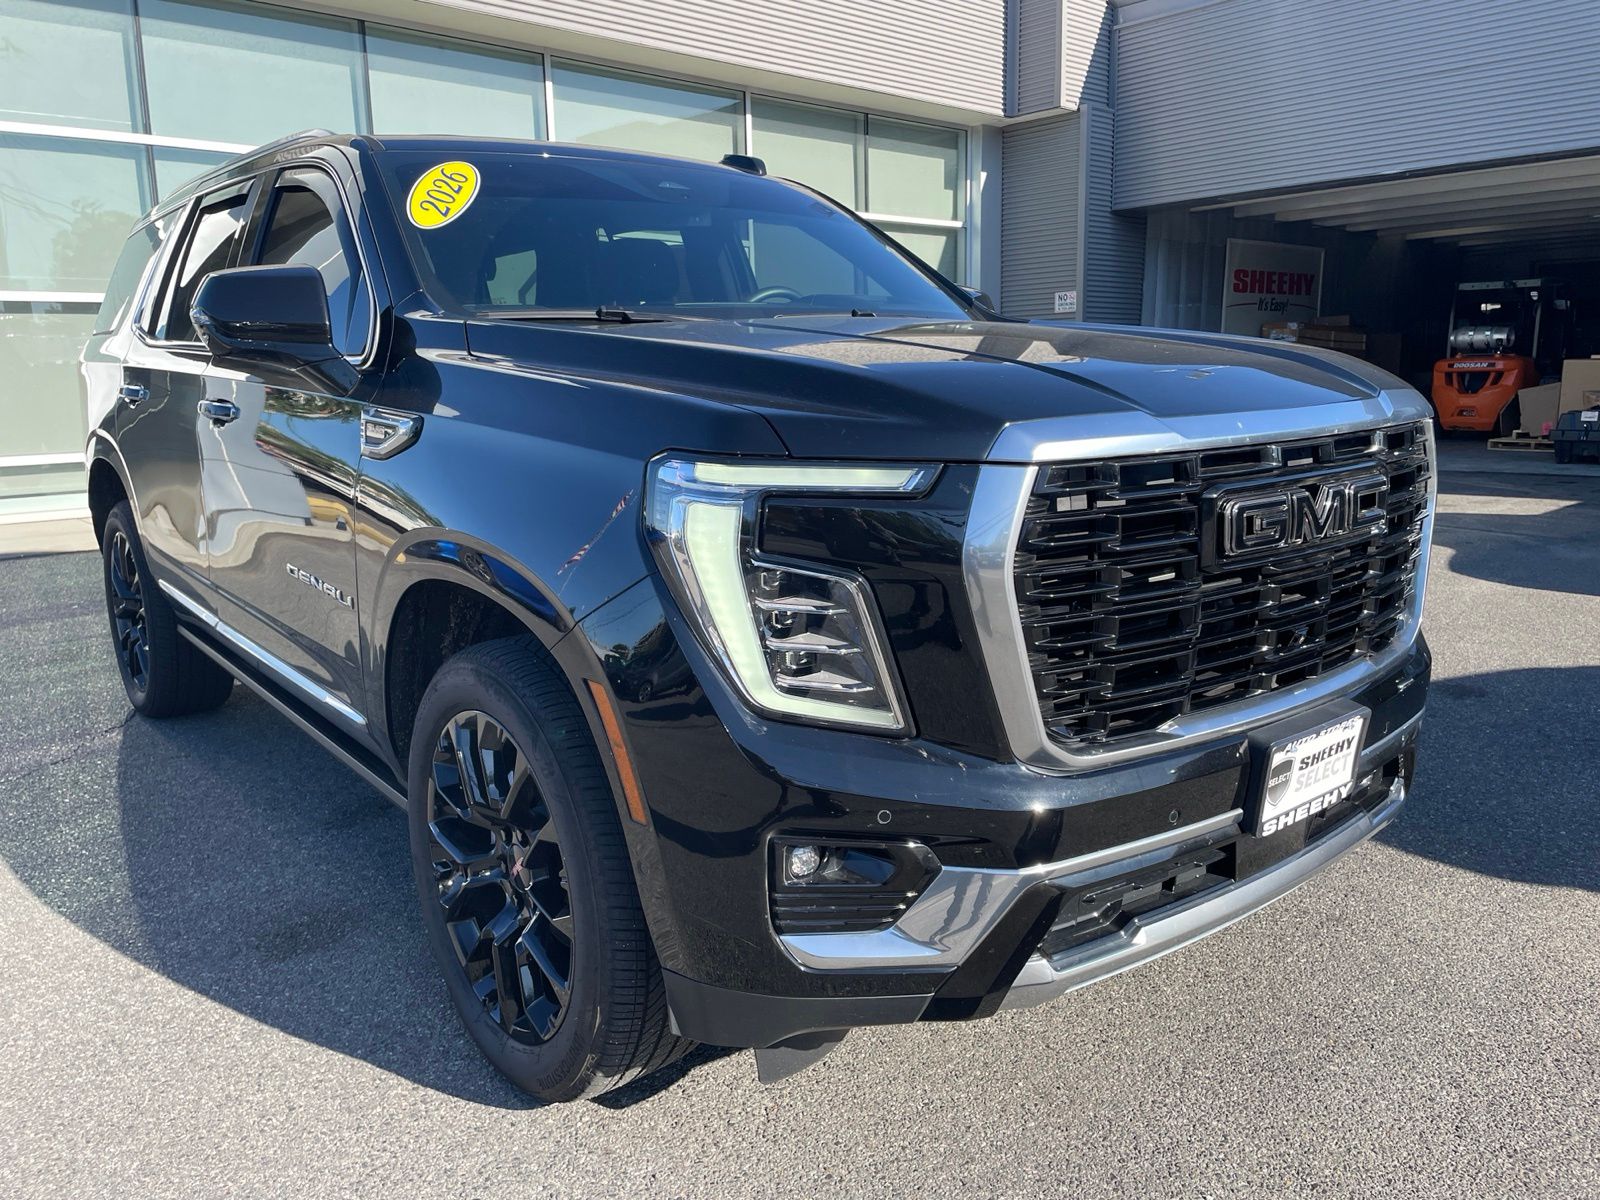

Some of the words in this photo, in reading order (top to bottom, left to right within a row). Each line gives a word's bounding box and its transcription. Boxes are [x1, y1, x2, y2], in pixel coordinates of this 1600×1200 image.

[419, 167, 469, 218] 2026
[1232, 268, 1315, 296] SHEEHY
[1270, 298, 1290, 315] Easy!
[1453, 361, 1488, 369] DOOSAN
[1222, 475, 1390, 556] GMC
[286, 562, 354, 608] DENALI
[1298, 735, 1356, 771] SHEEHY
[1267, 772, 1292, 788] SELECT
[1294, 752, 1352, 793] SELECT
[1261, 781, 1354, 838] SHEEHY
